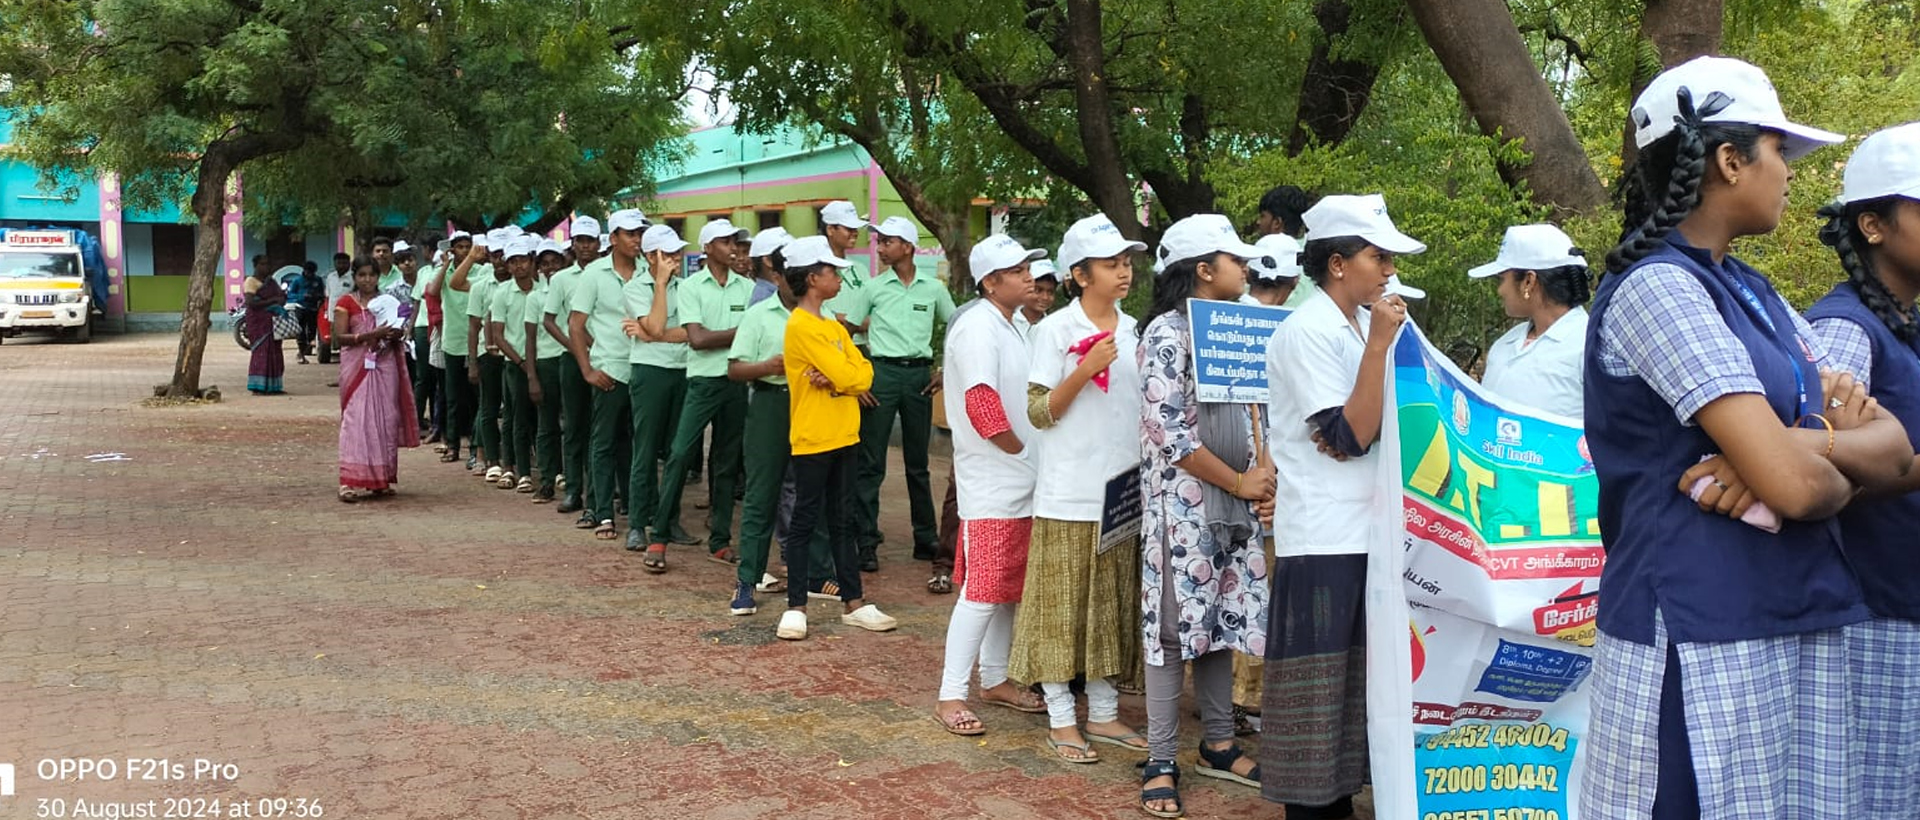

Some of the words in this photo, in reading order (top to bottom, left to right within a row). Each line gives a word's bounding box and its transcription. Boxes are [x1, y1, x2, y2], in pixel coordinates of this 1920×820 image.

[1210, 310, 1243, 326] நீங்கள்
[1245, 318, 1281, 329] தானமா
[1200, 346, 1266, 363] பார்வையற்றவ
[1507, 448, 1543, 465] India
[1424, 765, 1487, 795] 72000
[1490, 763, 1559, 792] 30442
